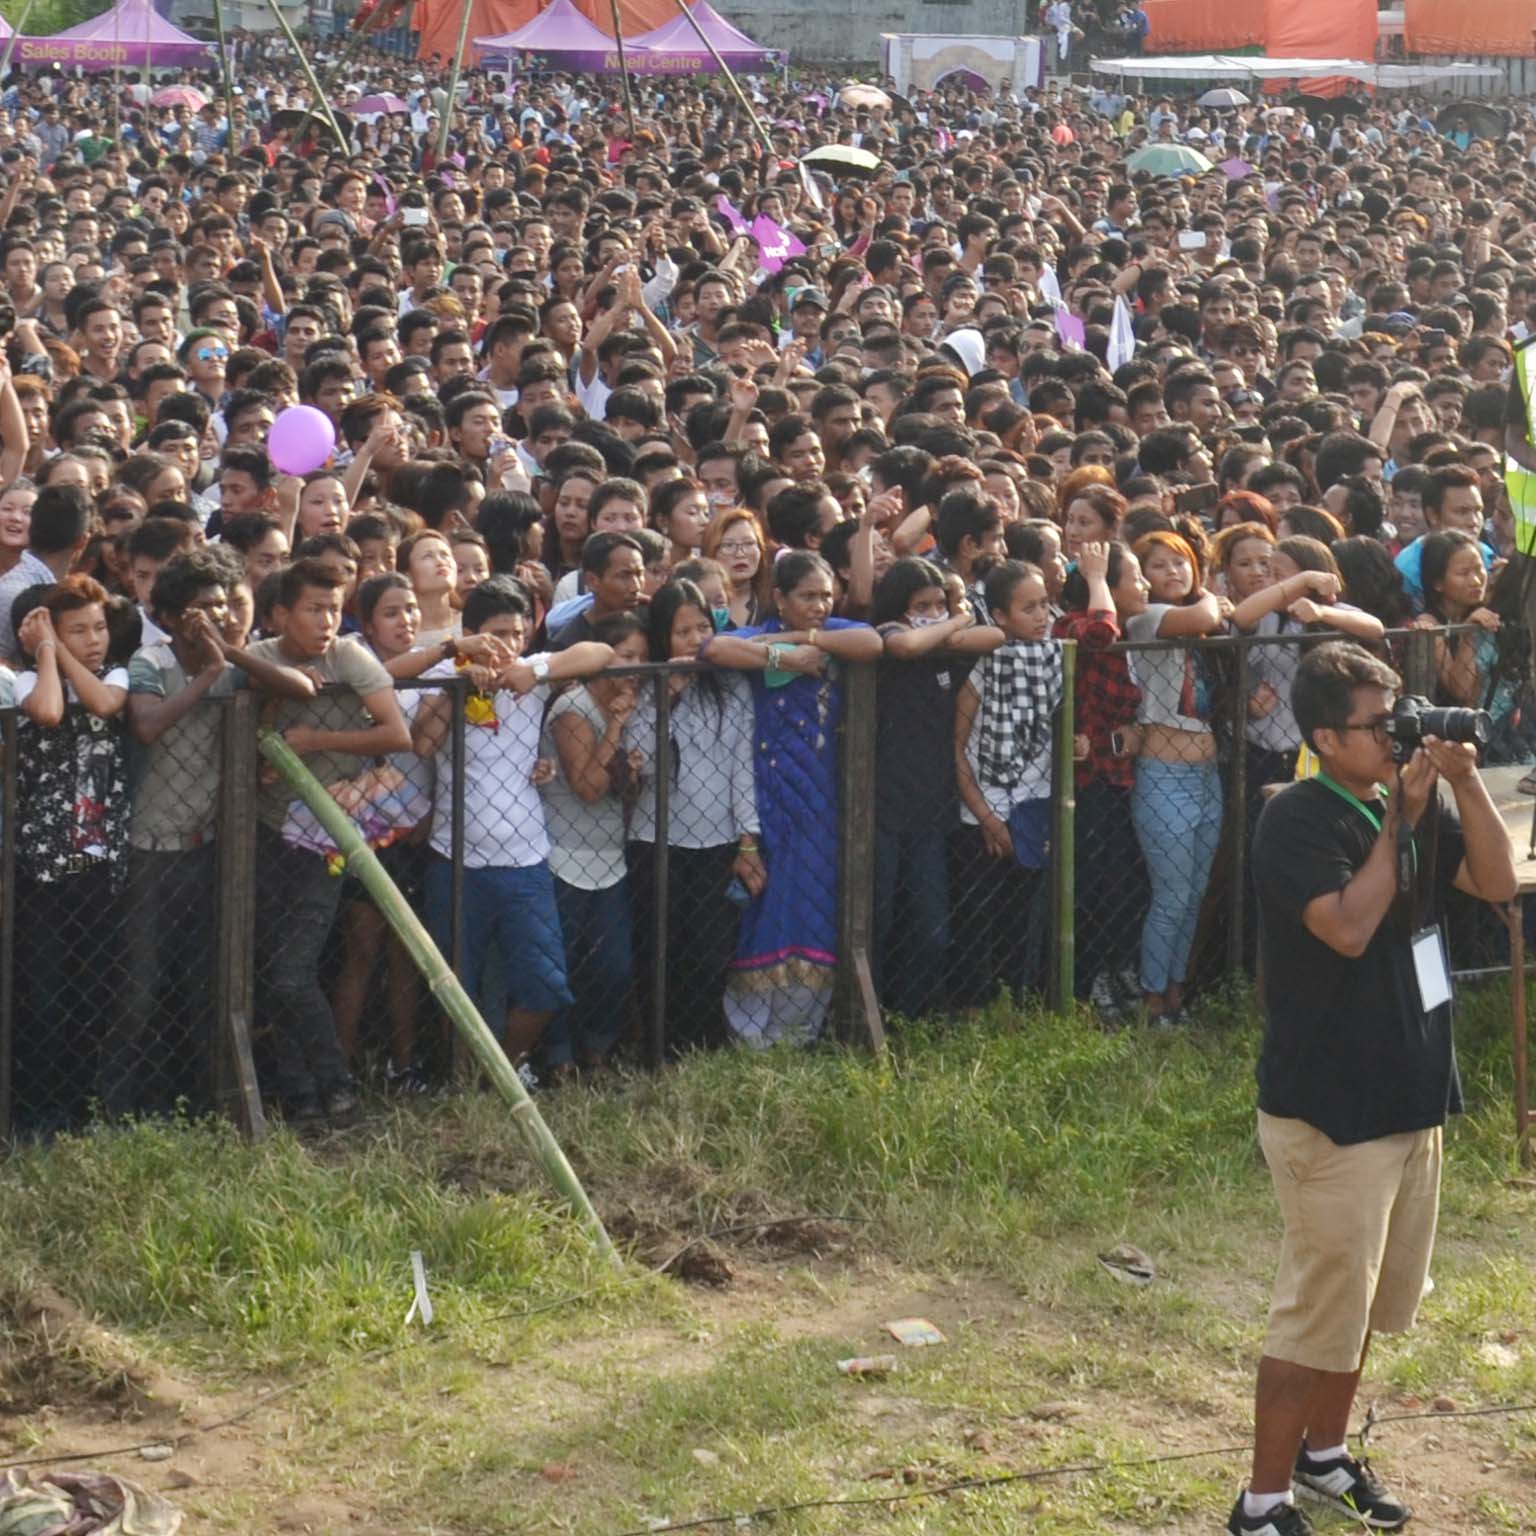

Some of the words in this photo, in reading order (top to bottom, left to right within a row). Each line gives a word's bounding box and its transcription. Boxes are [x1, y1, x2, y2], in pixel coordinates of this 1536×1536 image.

[21, 42, 71, 60] Sales
[74, 44, 127, 61] Booth
[649, 54, 702, 69] Centre
